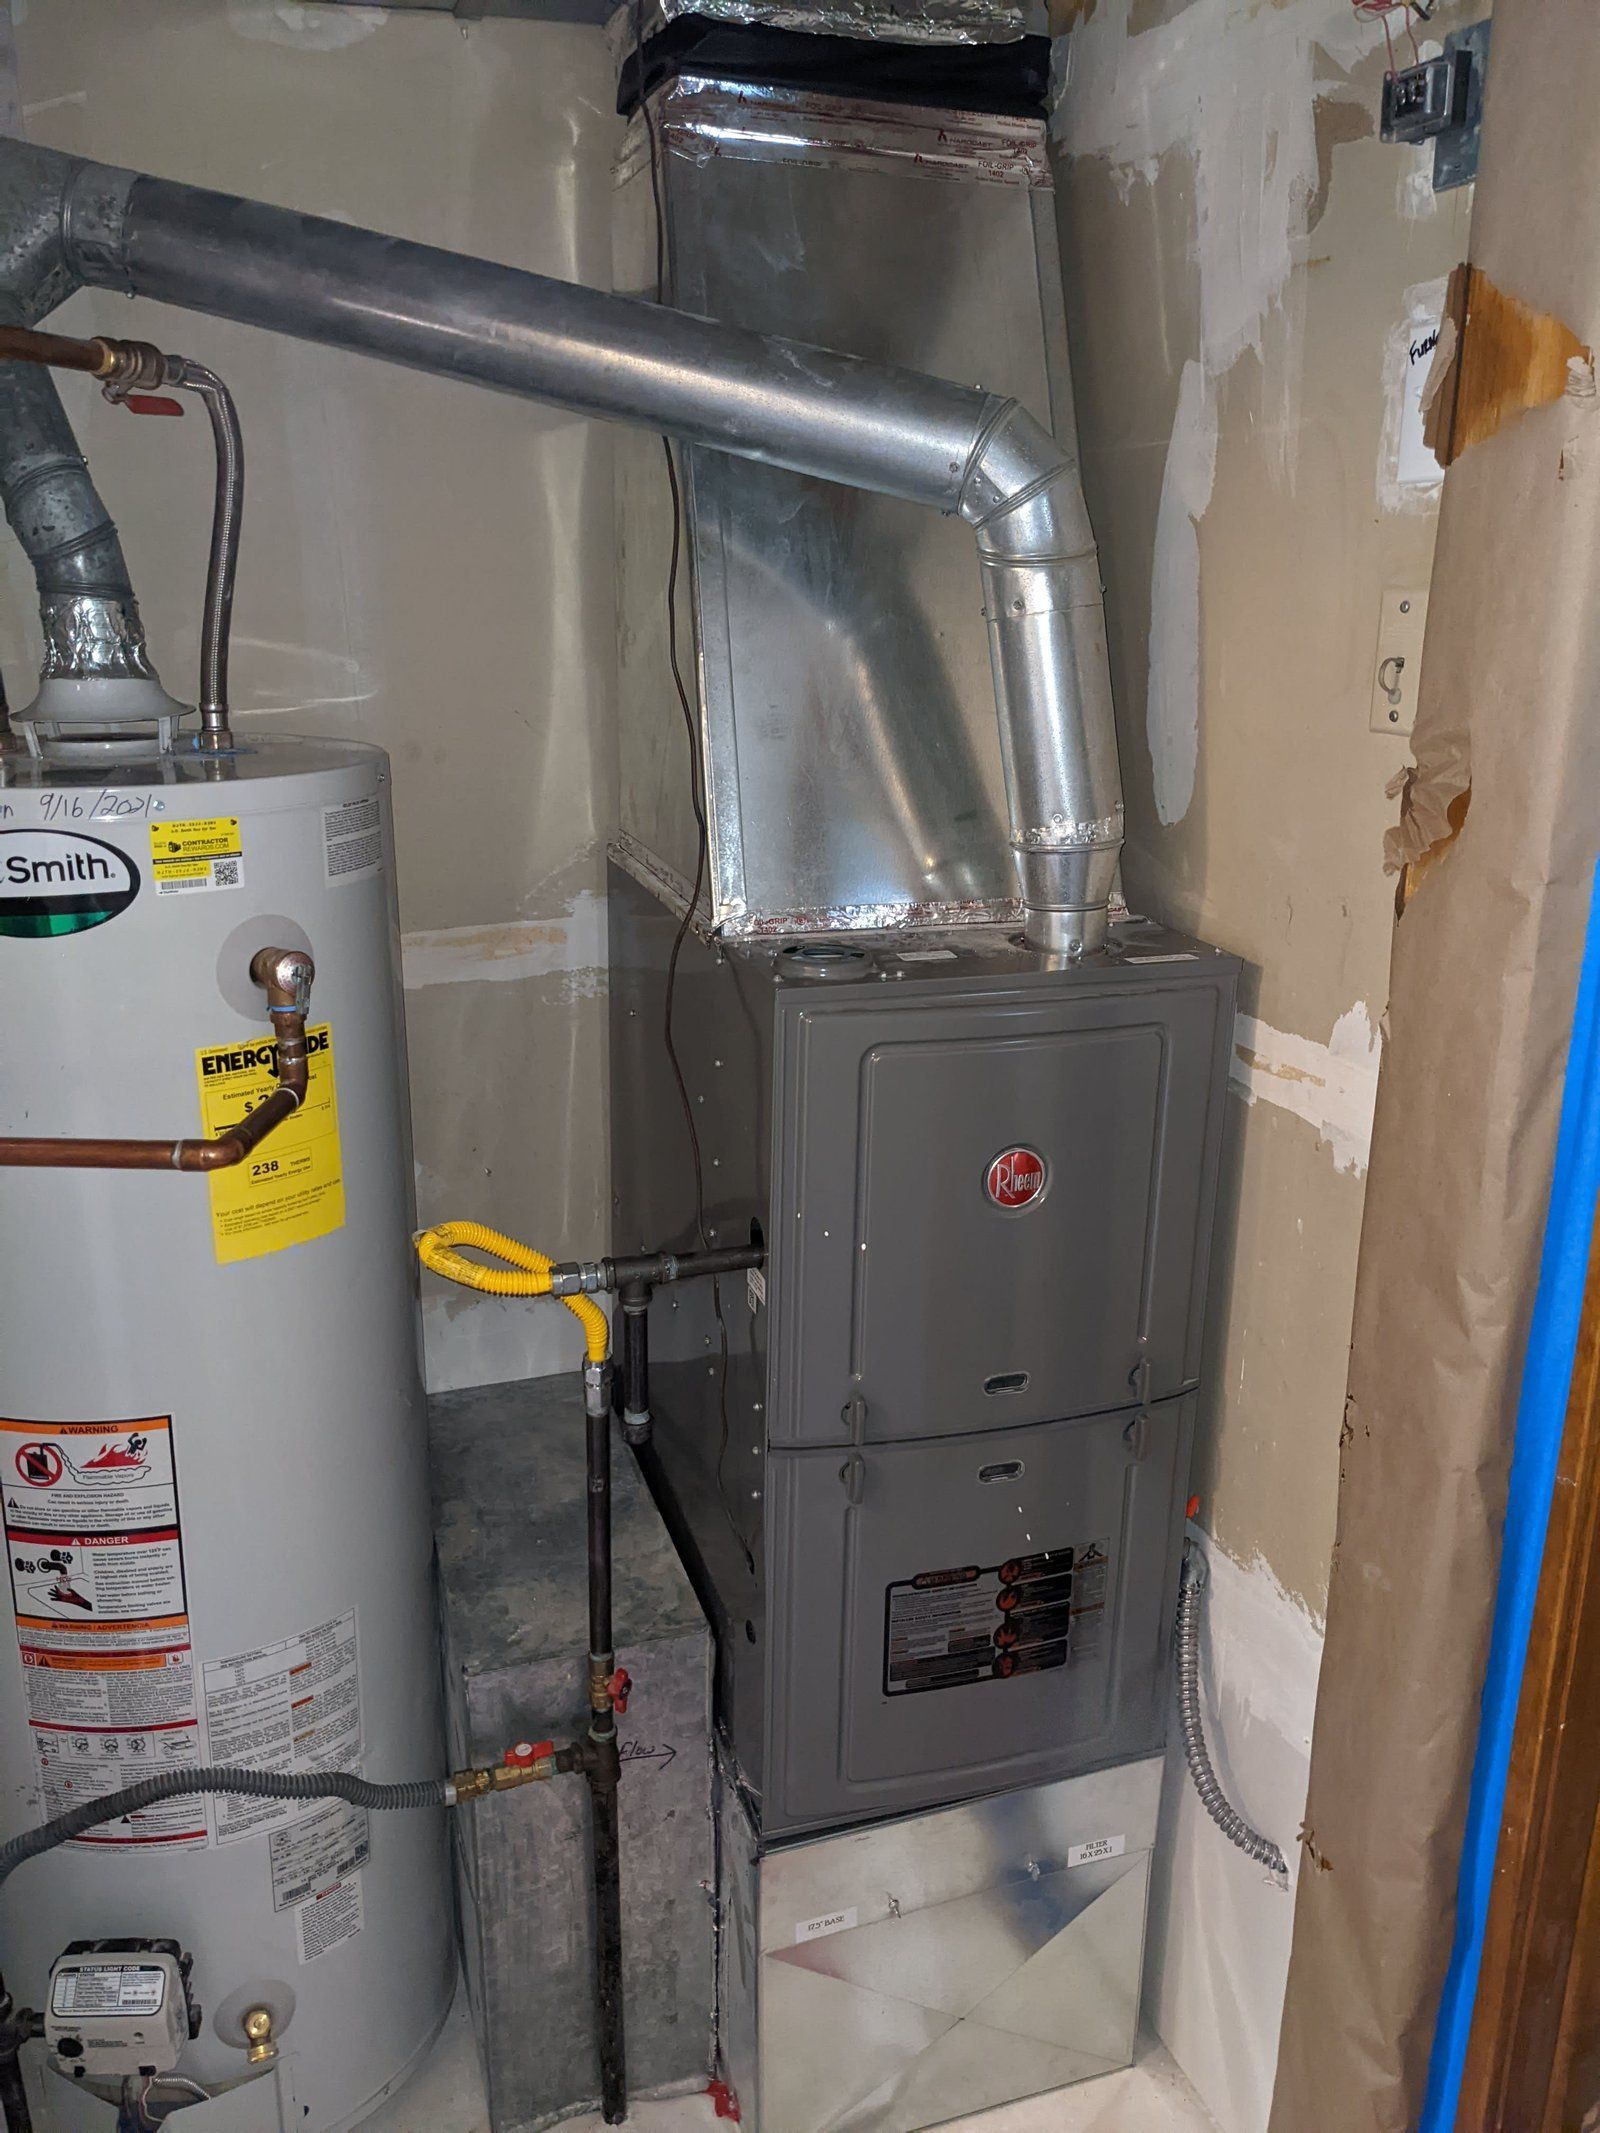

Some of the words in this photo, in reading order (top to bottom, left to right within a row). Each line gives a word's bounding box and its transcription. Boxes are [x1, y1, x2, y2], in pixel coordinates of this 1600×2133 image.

[978, 160, 1014, 170] FOIL-GRIP
[988, 170, 1004, 178] 1402
[1409, 329, 1440, 366] FURN
[182, 837, 228, 847] CONTRACTOR
[182, 843, 230, 852] REWARDS.COM
[6, 852, 110, 884] Smith
[222, 1089, 254, 1100] Estimated
[256, 1084, 275, 1095] Yearly
[244, 1101, 254, 1114] $
[252, 1160, 279, 1176] 238
[996, 1156, 1041, 1198] Rheem
[68, 1426, 118, 1434] WARNING
[84, 1536, 128, 1545] DANGER
[96, 1622, 150, 1630] ADVERTENCIA
[1086, 1840, 1108, 1850] FILTER
[824, 1914, 844, 1926] BASE
